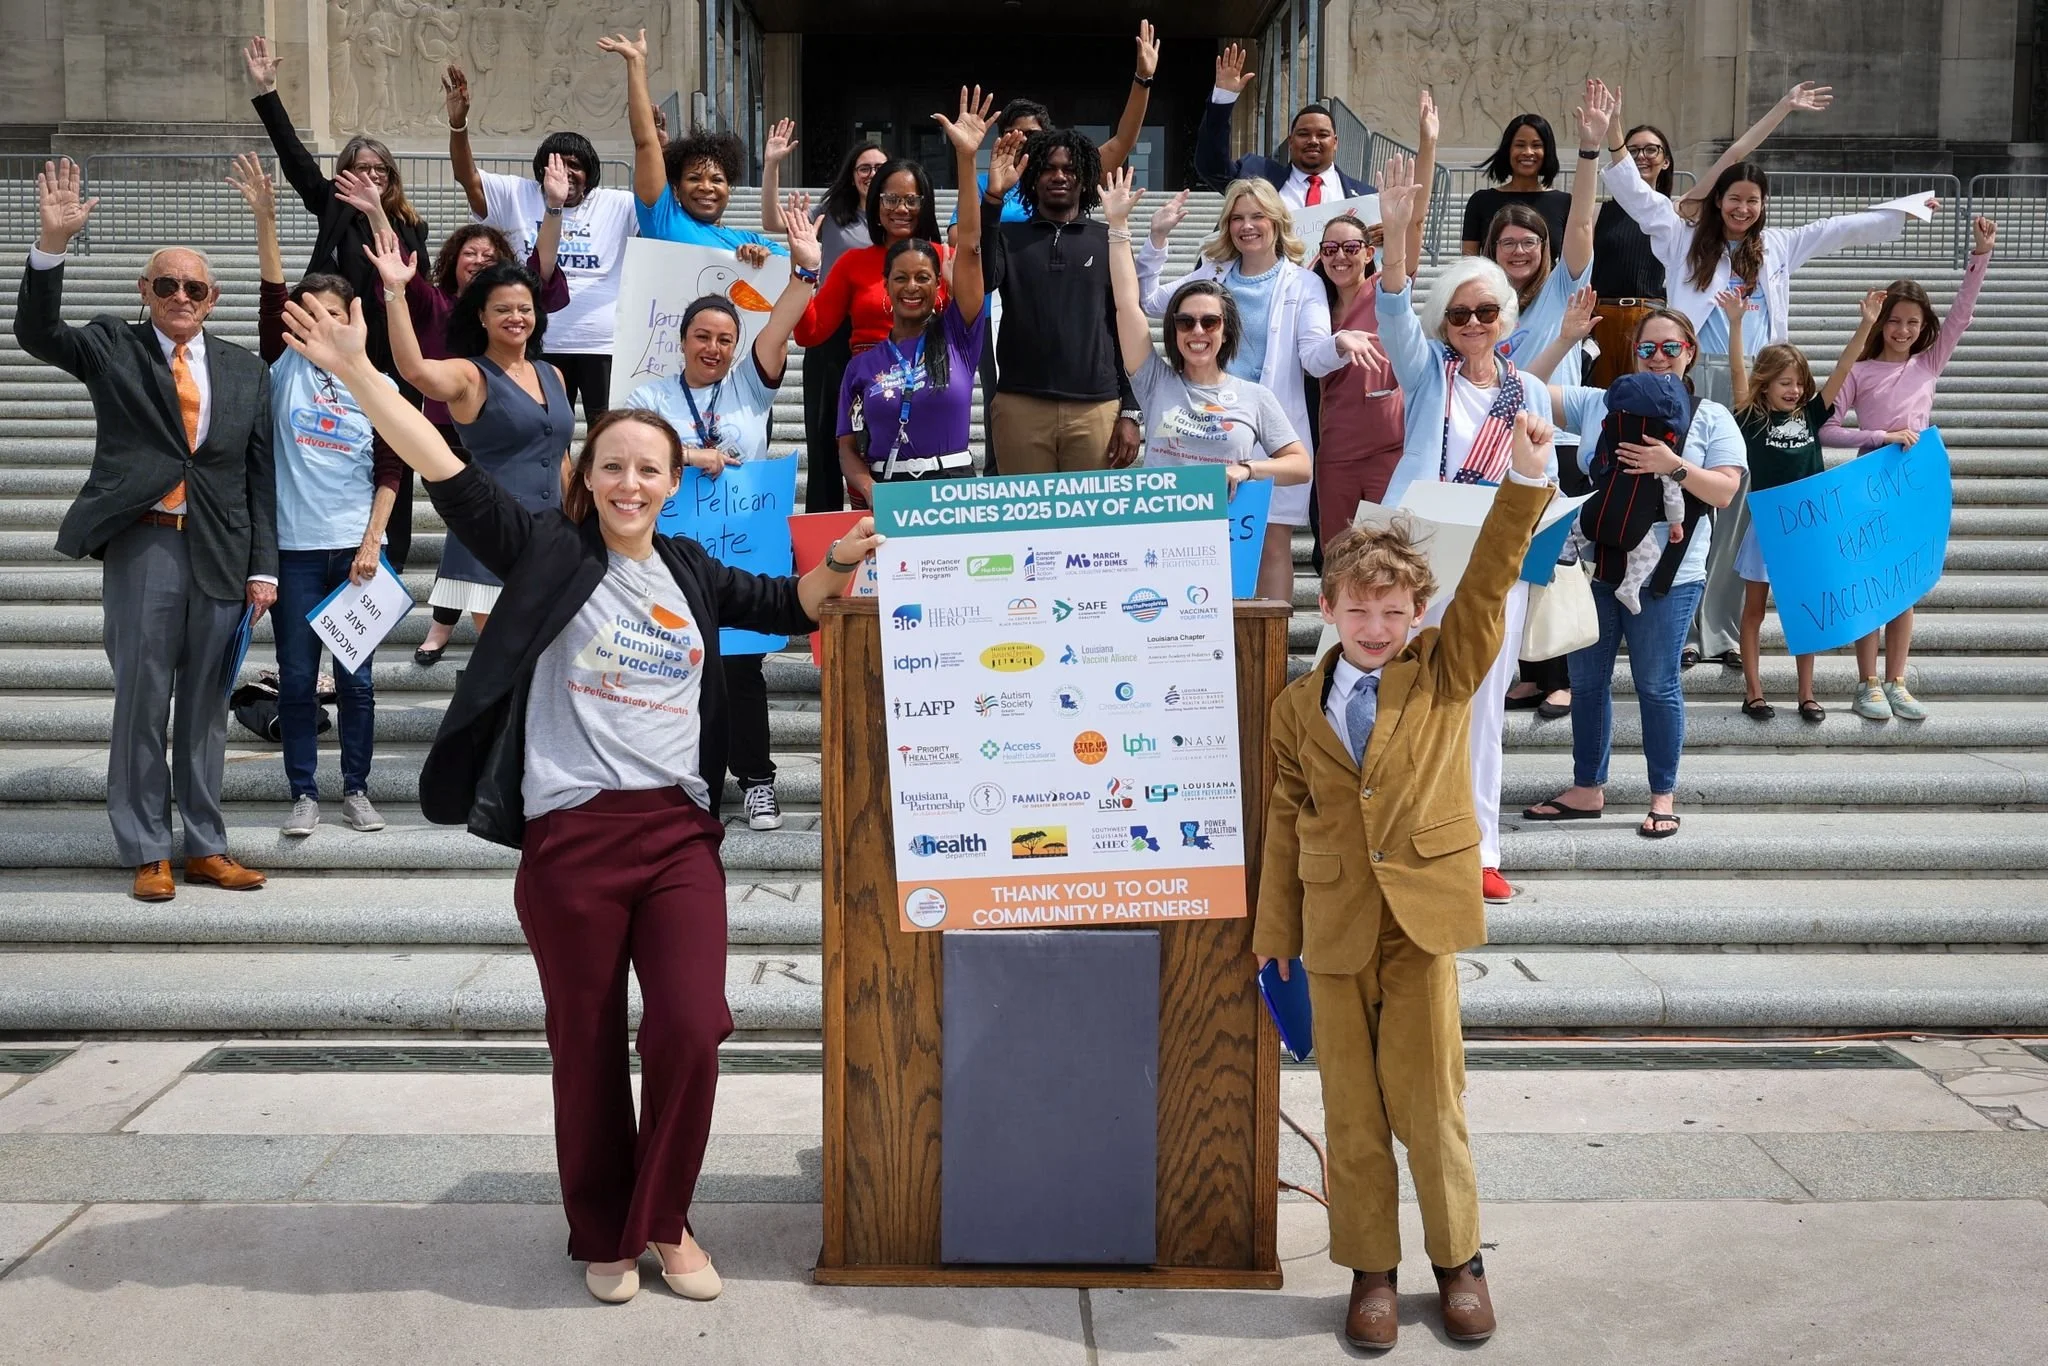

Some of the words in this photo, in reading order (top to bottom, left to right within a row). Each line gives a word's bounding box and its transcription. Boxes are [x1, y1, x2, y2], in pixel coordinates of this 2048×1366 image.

[647, 356, 668, 374] for
[295, 435, 352, 452] Advocate
[1765, 438, 1788, 448] Lake
[1160, 448, 1180, 457] Pelican
[931, 480, 1041, 502] LOUISIANA
[1044, 475, 1133, 497] FAMILIES
[1136, 472, 1177, 491] FOR
[696, 474, 776, 517] Pelican
[1777, 483, 1845, 536] DON'T
[1866, 457, 1925, 503] GIVE
[893, 506, 999, 527] VACCINES
[1002, 502, 1052, 521] 2025
[1055, 500, 1099, 518] DAY
[1102, 497, 1129, 515] OF
[1133, 493, 1214, 514] ACTION
[1161, 545, 1216, 557] FAMILIES
[1161, 559, 1200, 568] FIGHTING
[360, 593, 381, 620] LIVES
[928, 606, 980, 617] HEALTH
[1078, 601, 1108, 611] SAFE
[344, 609, 367, 636] SAVE
[893, 616, 919, 631] Bio
[929, 616, 966, 628] HERO
[616, 614, 691, 646] louisiana
[320, 614, 358, 661] VACCINES
[614, 631, 683, 662] families
[1081, 645, 1113, 654] Louisiana
[595, 647, 613, 659] for
[619, 653, 689, 680] vaccines
[893, 655, 931, 673] idpn
[1082, 655, 1109, 664] Vaccine
[1111, 654, 1138, 663] Alliance
[567, 680, 584, 692] The
[584, 686, 621, 702] Pelican
[622, 696, 648, 708] State
[1001, 691, 1031, 700] Autism
[905, 700, 955, 717] LAFP
[1001, 700, 1033, 708] Society
[1003, 742, 1041, 751] Access
[1184, 735, 1226, 746] NASW
[909, 753, 937, 761] HEALTH
[1182, 782, 1235, 790] LOUISIANA
[900, 791, 949, 804] Louisiana
[1012, 793, 1050, 803] FAMILY
[1059, 791, 1091, 801] ROAD
[910, 800, 965, 812] Partnership
[920, 833, 987, 854] health
[1092, 840, 1129, 849] AHEC
[991, 884, 1059, 903] THANK
[1063, 881, 1106, 899] YOU
[1113, 880, 1142, 897] TO
[1145, 878, 1188, 895] OUR
[973, 903, 1096, 926] COMMUNITY
[1103, 898, 1209, 919] PARTNERS!
